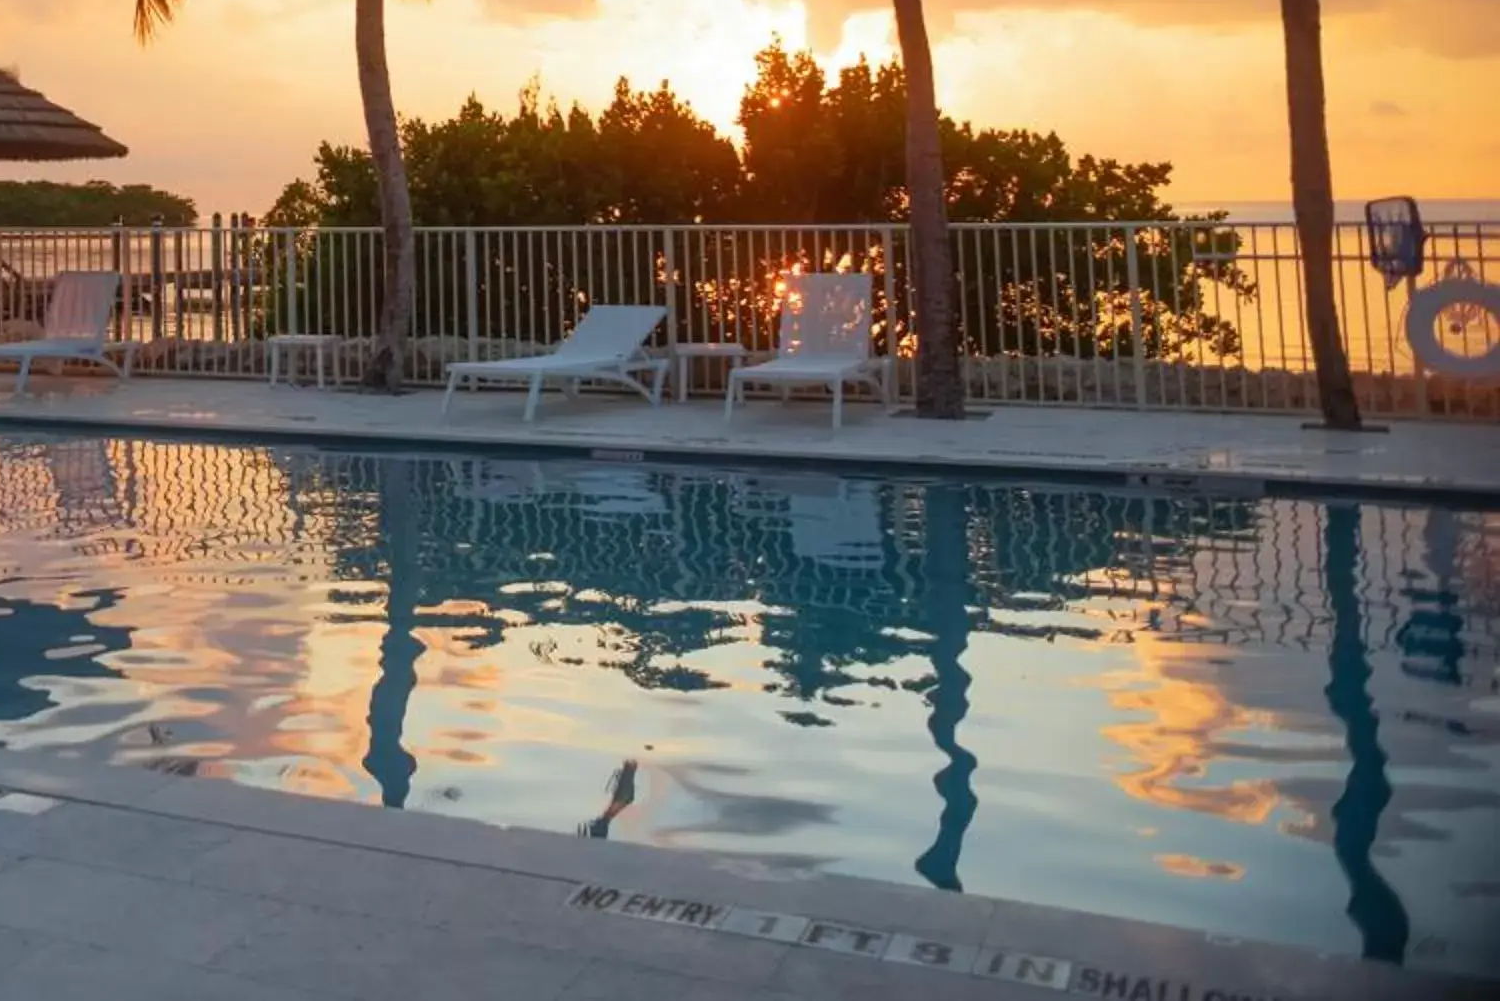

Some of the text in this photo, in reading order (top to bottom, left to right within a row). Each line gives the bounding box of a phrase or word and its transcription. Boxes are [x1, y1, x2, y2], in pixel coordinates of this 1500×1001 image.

[571, 886, 620, 909] NO
[621, 894, 723, 925] ENTRY
[758, 916, 779, 934] 1
[806, 923, 882, 951] FT
[988, 953, 1057, 982] IN
[1078, 967, 1262, 1001] SHALL
